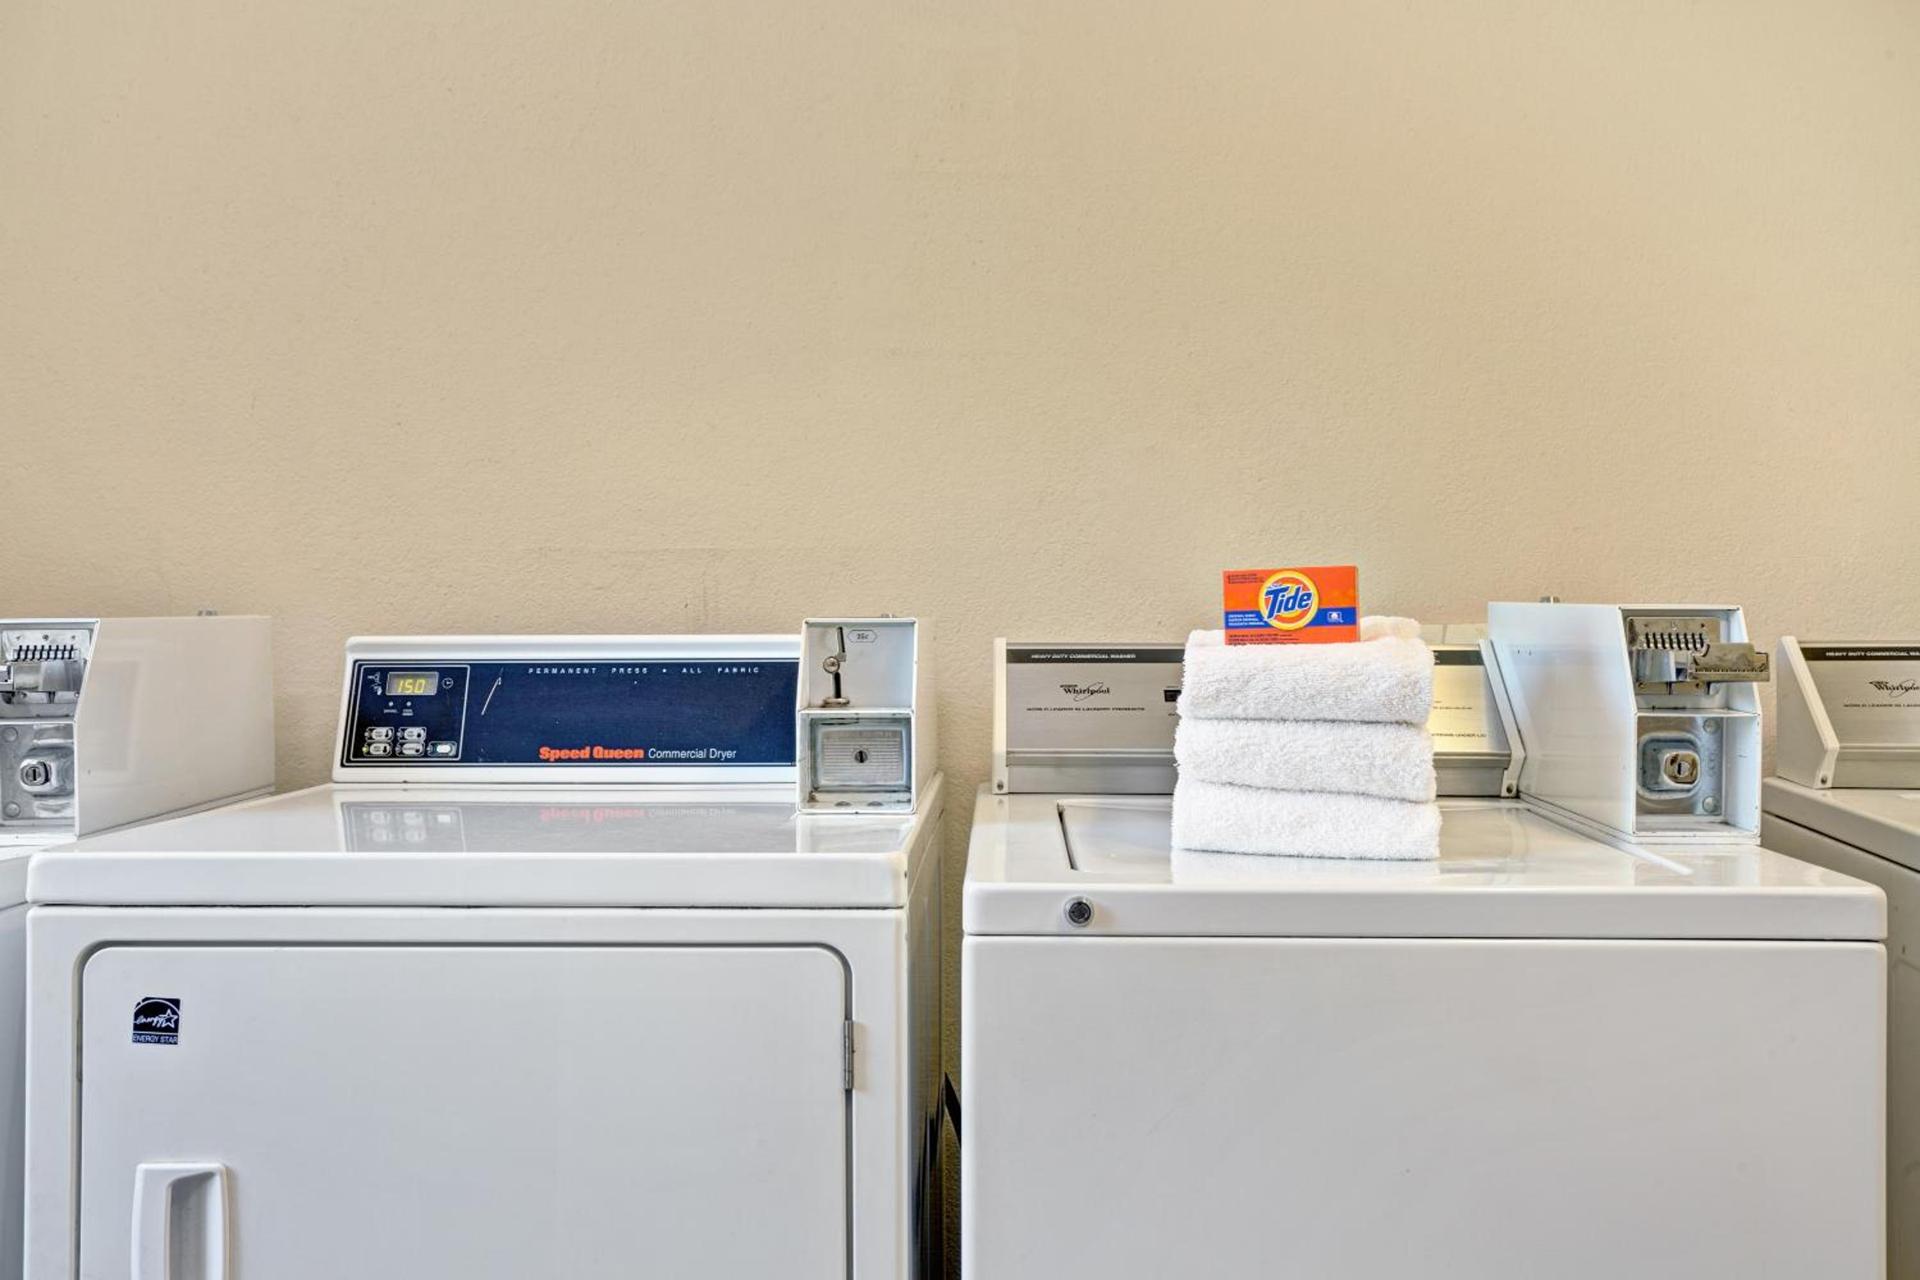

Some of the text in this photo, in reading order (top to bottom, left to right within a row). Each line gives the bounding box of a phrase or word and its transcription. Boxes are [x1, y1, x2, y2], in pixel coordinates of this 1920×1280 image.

[1264, 585, 1313, 620] Tide
[527, 667, 598, 675] PERMANENT
[610, 667, 649, 675] PRESS
[716, 666, 760, 674] FABRIC
[538, 745, 737, 761] Speed Queen Commercial Dryer
